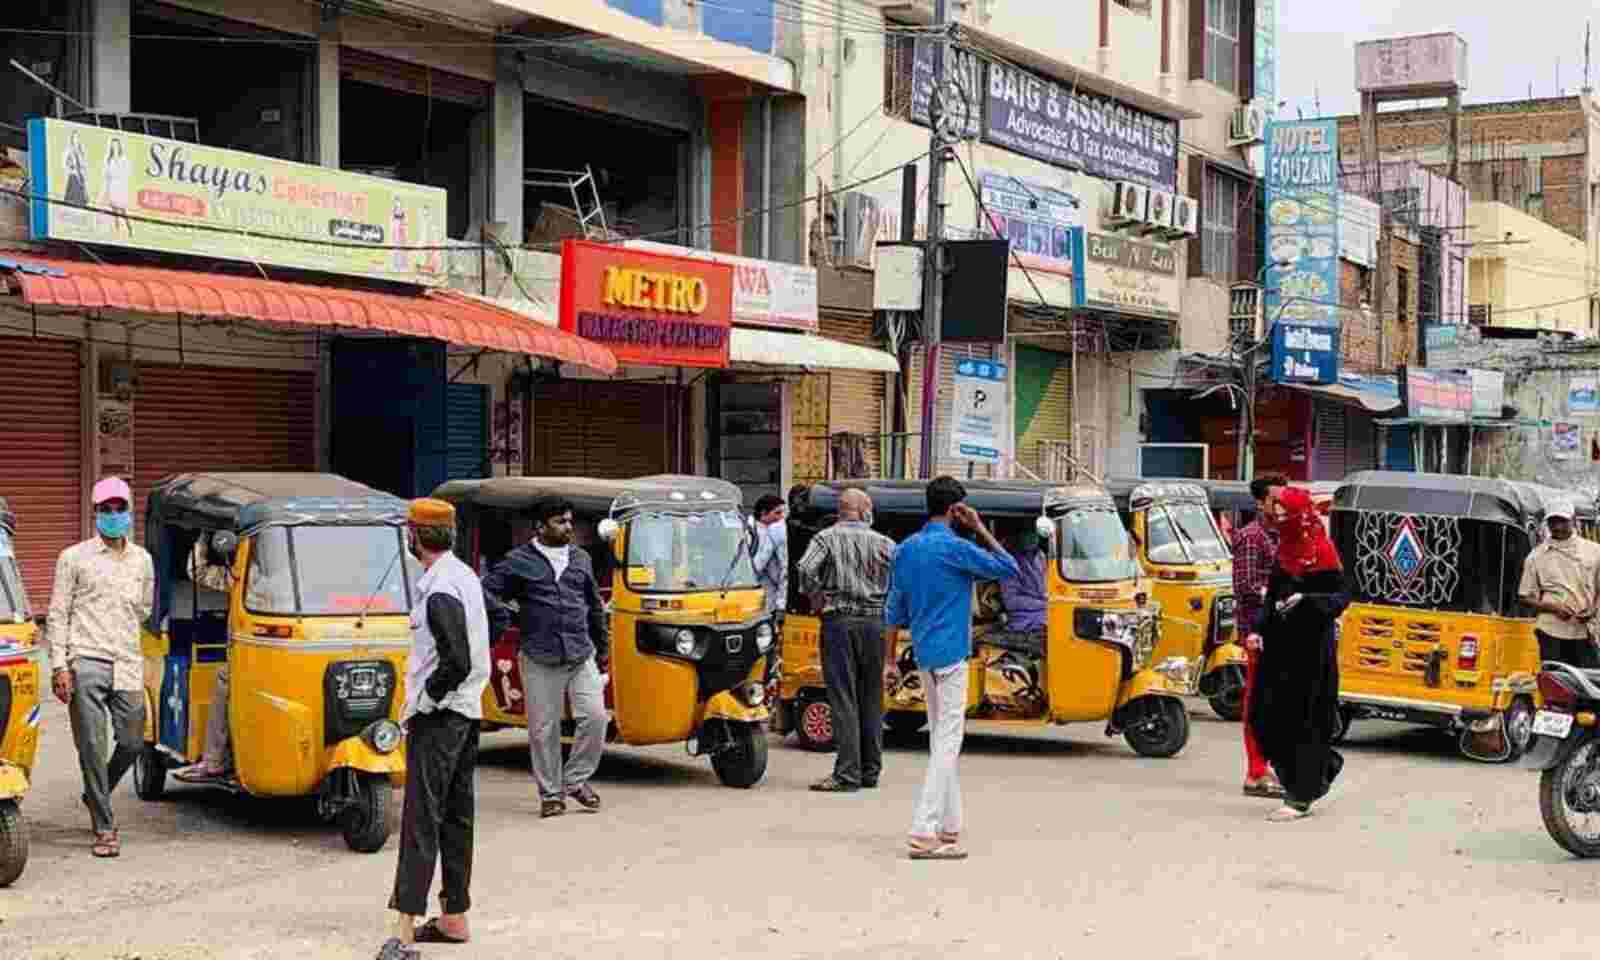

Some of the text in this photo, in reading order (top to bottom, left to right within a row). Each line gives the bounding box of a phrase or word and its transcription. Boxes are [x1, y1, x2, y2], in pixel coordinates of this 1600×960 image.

[990, 63, 1042, 113] BAIG
[1047, 83, 1061, 118] &
[1065, 93, 1175, 156] ASSOCIATES
[1007, 109, 1068, 148] Advocates
[1070, 132, 1081, 152] &
[1083, 134, 1100, 159] Tax
[1271, 128, 1329, 154] HOTEL
[145, 142, 267, 199] Shayas
[1271, 156, 1331, 184] FOUZAN
[604, 264, 708, 315] METRO
